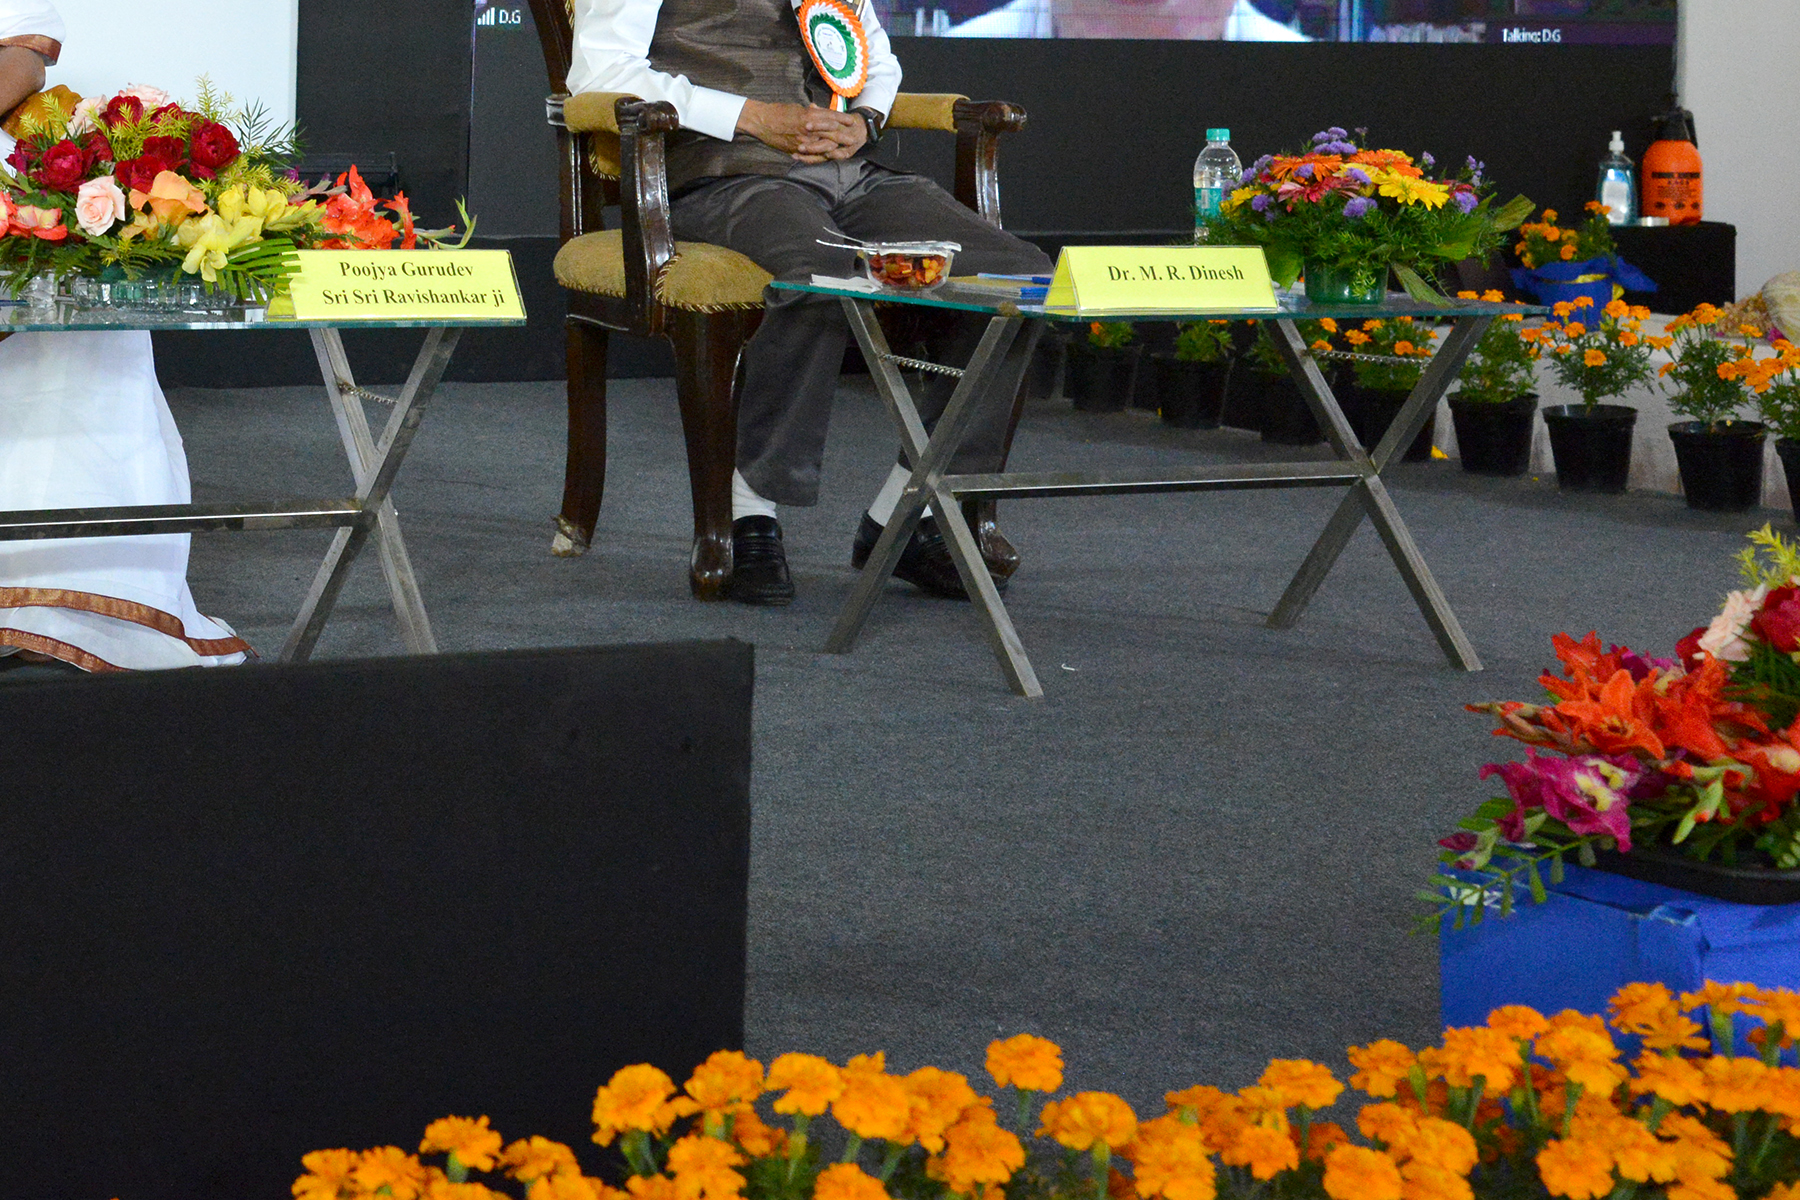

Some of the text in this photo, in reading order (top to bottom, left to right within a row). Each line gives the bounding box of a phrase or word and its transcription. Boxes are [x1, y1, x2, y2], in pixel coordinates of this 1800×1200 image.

[498, 8, 522, 25] D.G
[339, 261, 474, 281] Poojya Gurudev
[1107, 264, 1245, 282] Dr. M. R. Dinesh
[322, 288, 505, 308] Sri Sri Ravishankar ji
